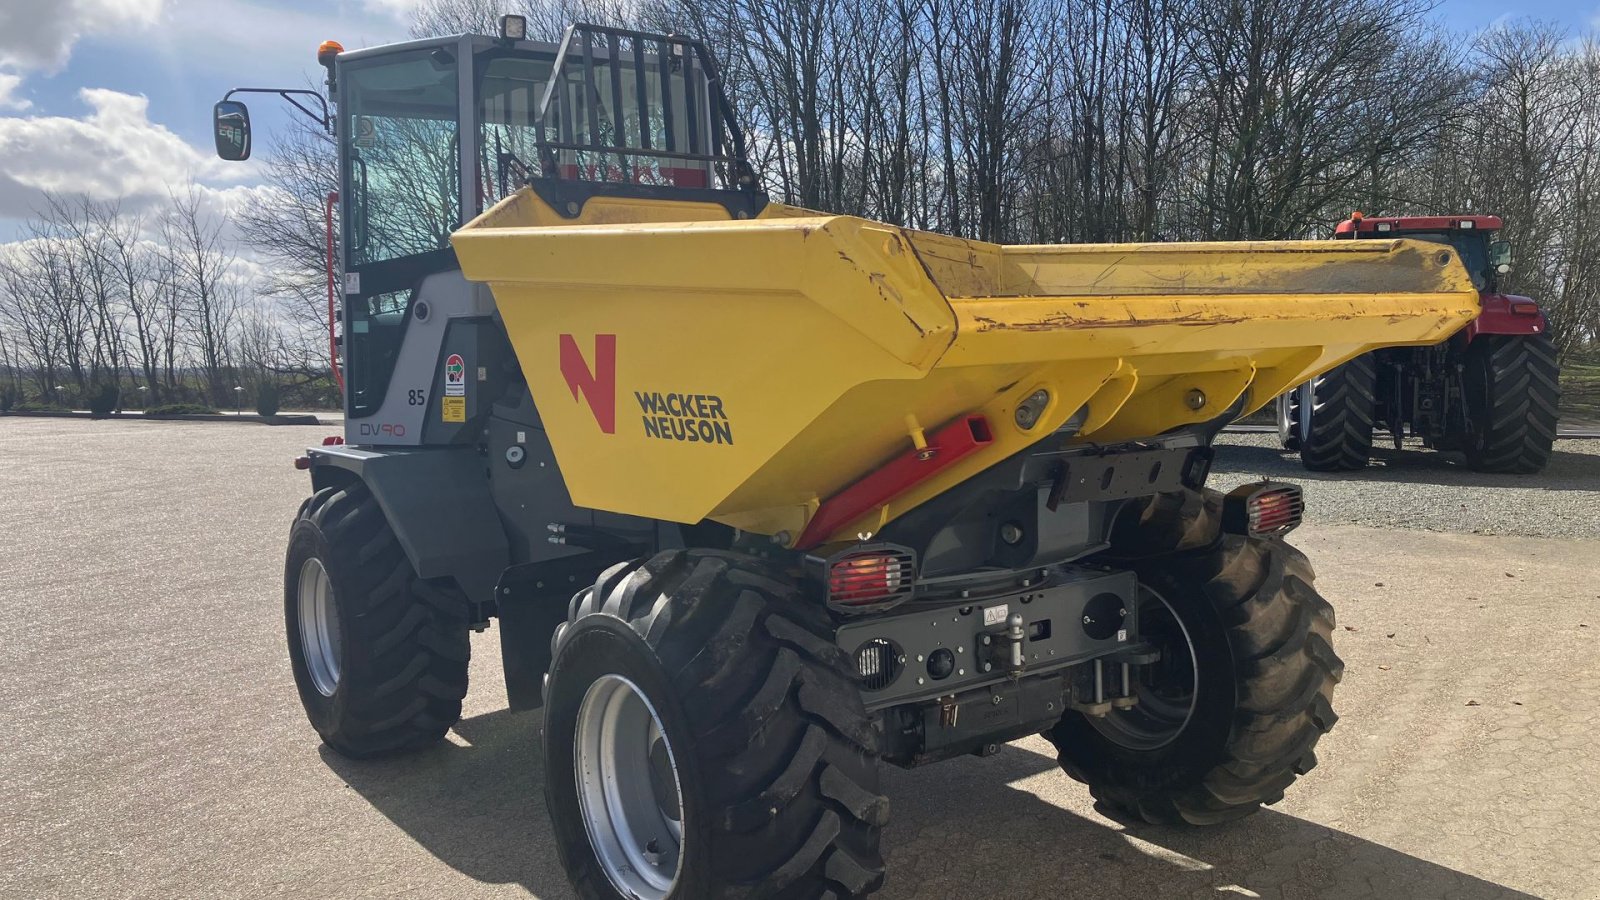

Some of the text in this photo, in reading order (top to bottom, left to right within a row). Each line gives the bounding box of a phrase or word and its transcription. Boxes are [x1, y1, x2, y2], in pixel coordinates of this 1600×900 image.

[408, 389, 425, 406] 85
[634, 391, 728, 420] WACKER
[360, 423, 406, 437] DV90
[642, 415, 734, 446] NEUSON
